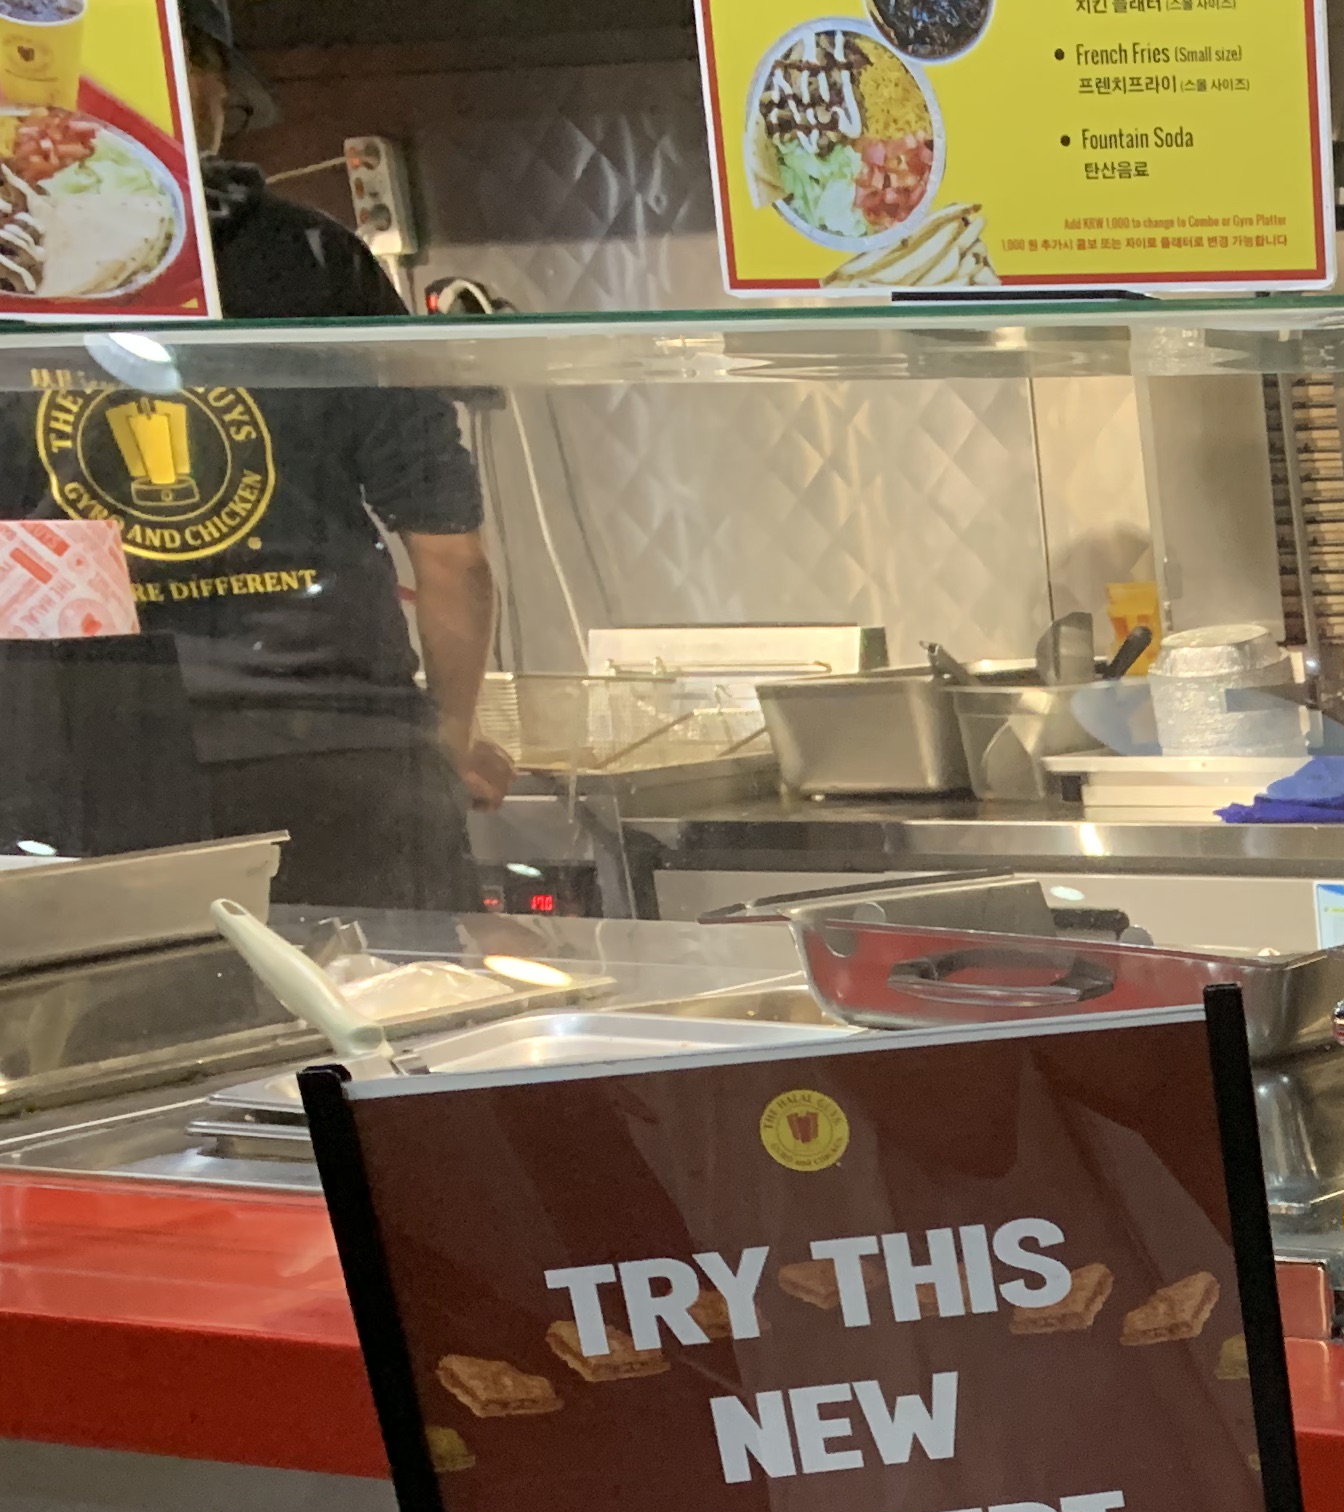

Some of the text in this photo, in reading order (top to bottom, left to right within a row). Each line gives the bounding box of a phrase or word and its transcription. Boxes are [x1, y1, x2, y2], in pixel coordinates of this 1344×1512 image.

[1076, 42, 1242, 65] French Fries (Small size)
[1078, 75, 1176, 95] 프렌치프라이
[1082, 126, 1194, 150] Fountain Soda
[1084, 161, 1150, 180] 탄산음료
[127, 525, 181, 549] AND
[185, 469, 263, 547] CHICKEN
[170, 569, 317, 600] DIFFERENT
[545, 1216, 1073, 1359] TRY THIS
[709, 1371, 960, 1484] NEW
